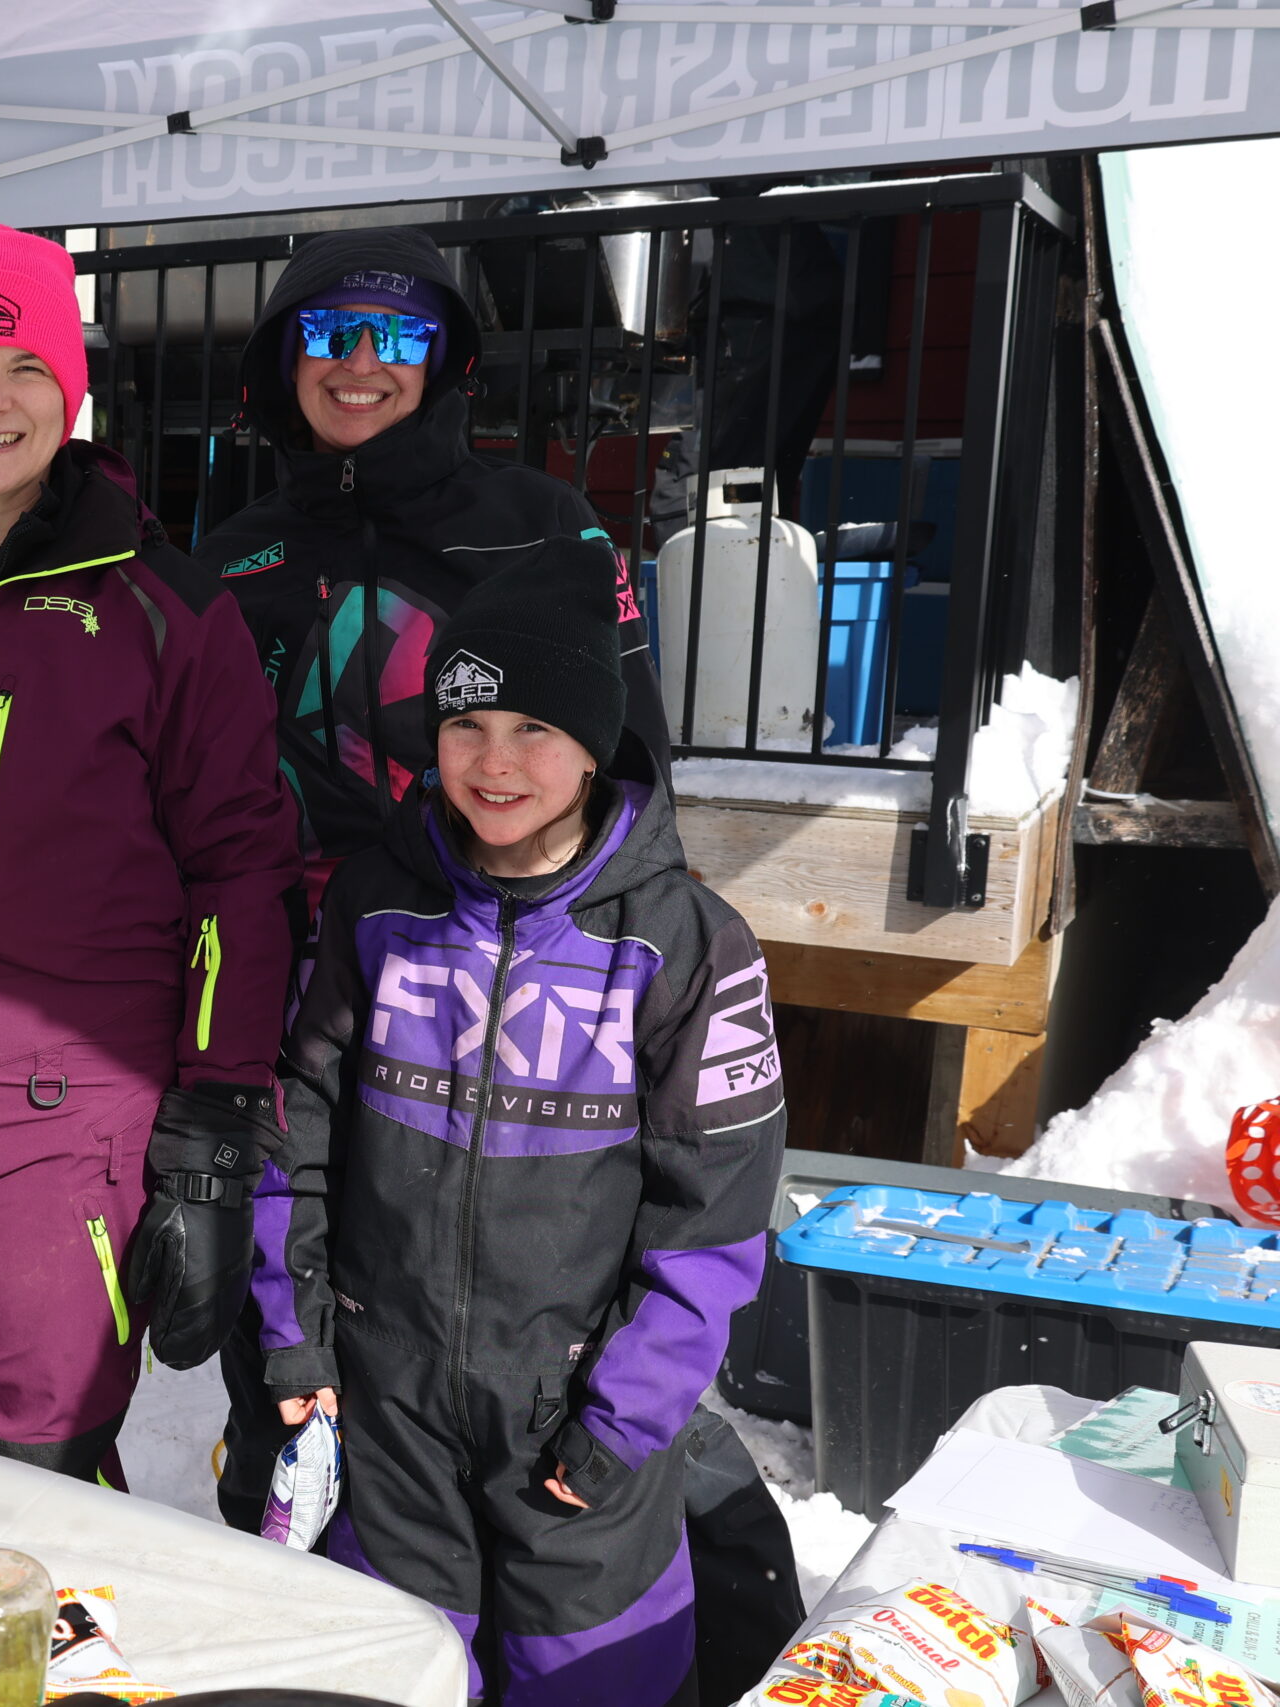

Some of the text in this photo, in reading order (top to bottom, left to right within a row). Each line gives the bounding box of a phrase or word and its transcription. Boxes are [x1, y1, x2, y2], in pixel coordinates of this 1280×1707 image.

[222, 542, 283, 575] FXR
[23, 596, 94, 618] DSG
[438, 683, 498, 705] SLED
[466, 695, 498, 704] RANGE
[370, 952, 636, 1084] FXR
[375, 1063, 624, 1120] RIDE DIVISION
[723, 1051, 779, 1092] FXR
[872, 1609, 961, 1673] Original
[905, 1586, 1000, 1662] Dutch
